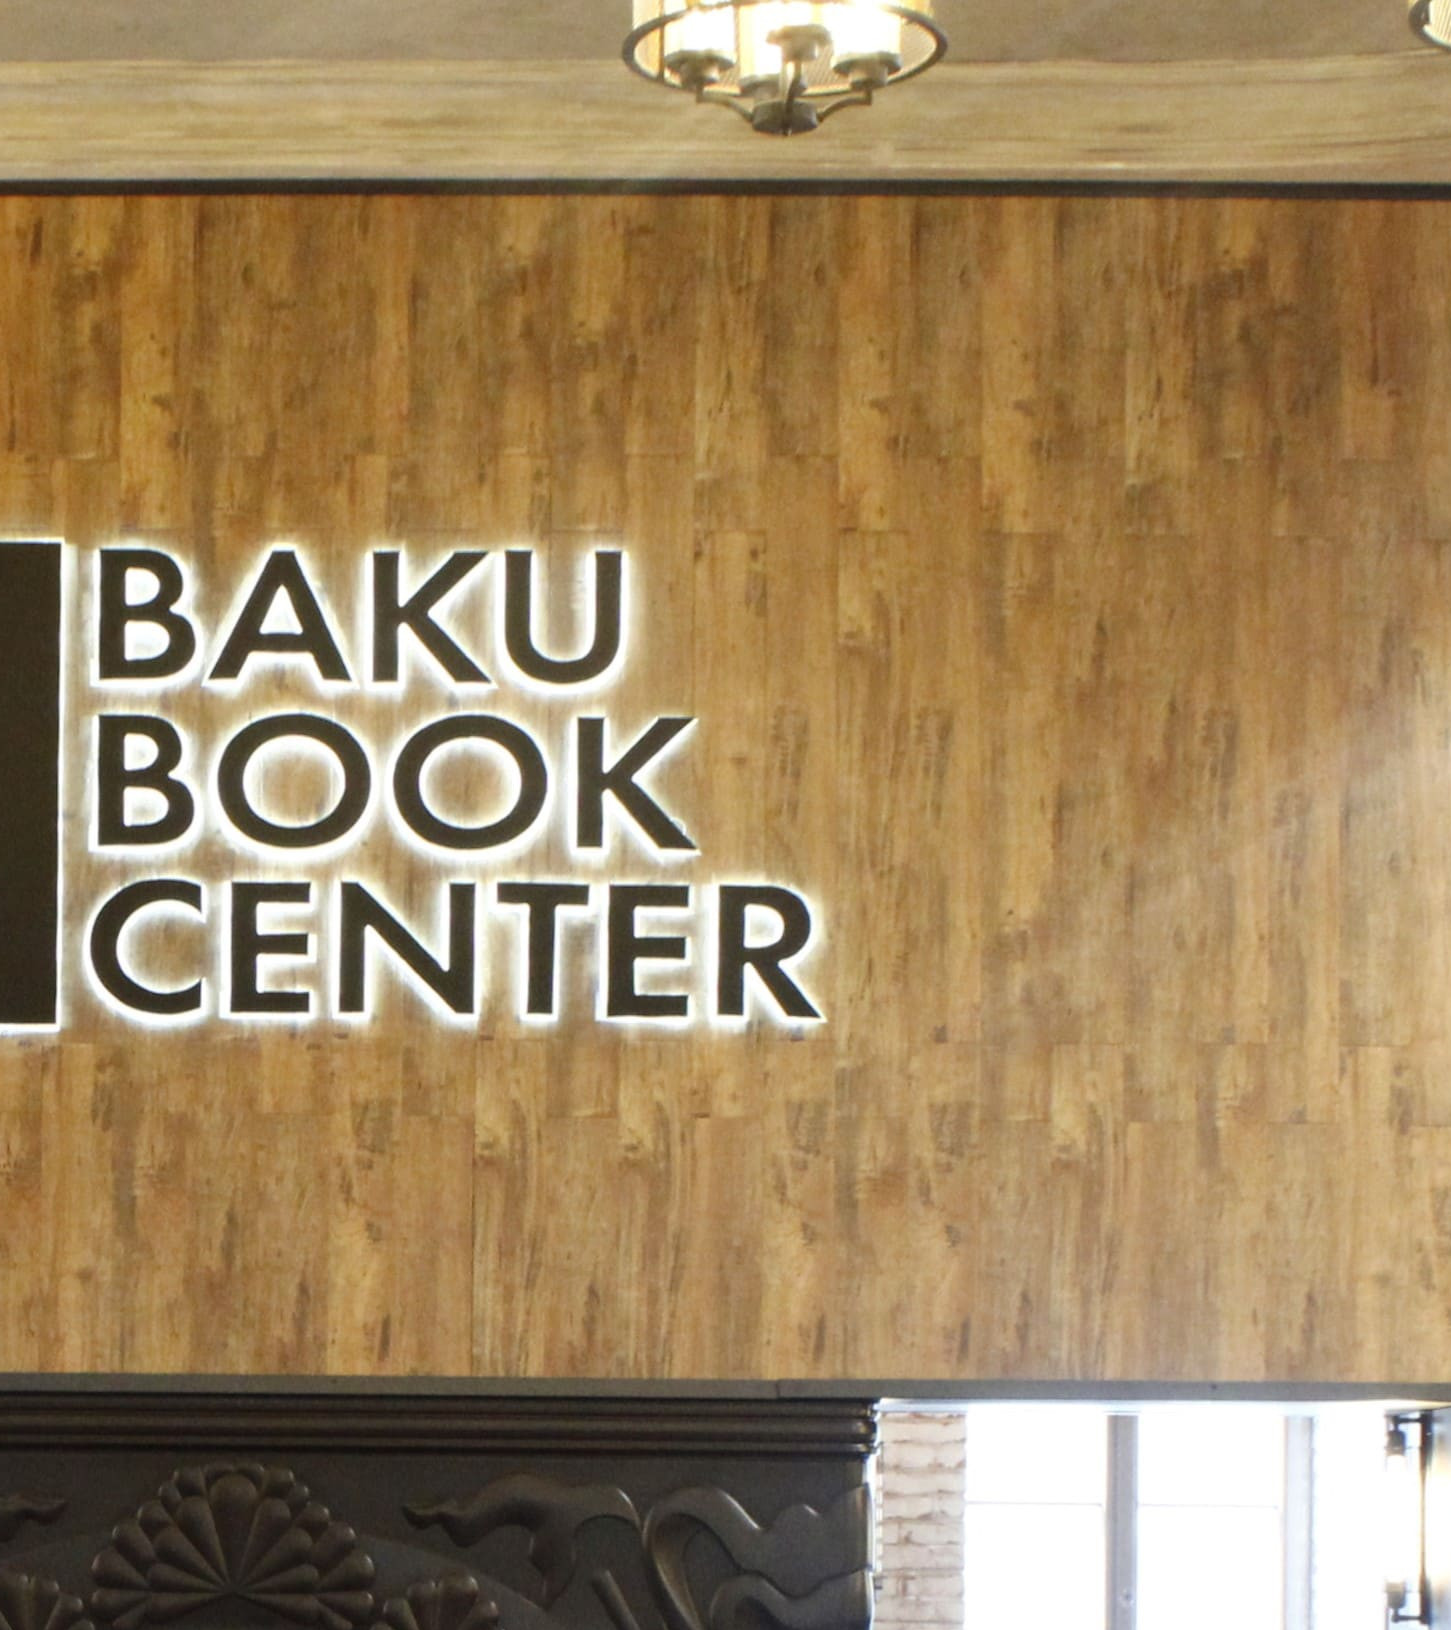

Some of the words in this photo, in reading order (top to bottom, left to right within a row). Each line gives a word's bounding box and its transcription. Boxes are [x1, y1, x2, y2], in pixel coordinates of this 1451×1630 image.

[97, 548, 622, 686] BAKU
[96, 712, 698, 852] BOOK
[89, 878, 824, 1021] CENTER
